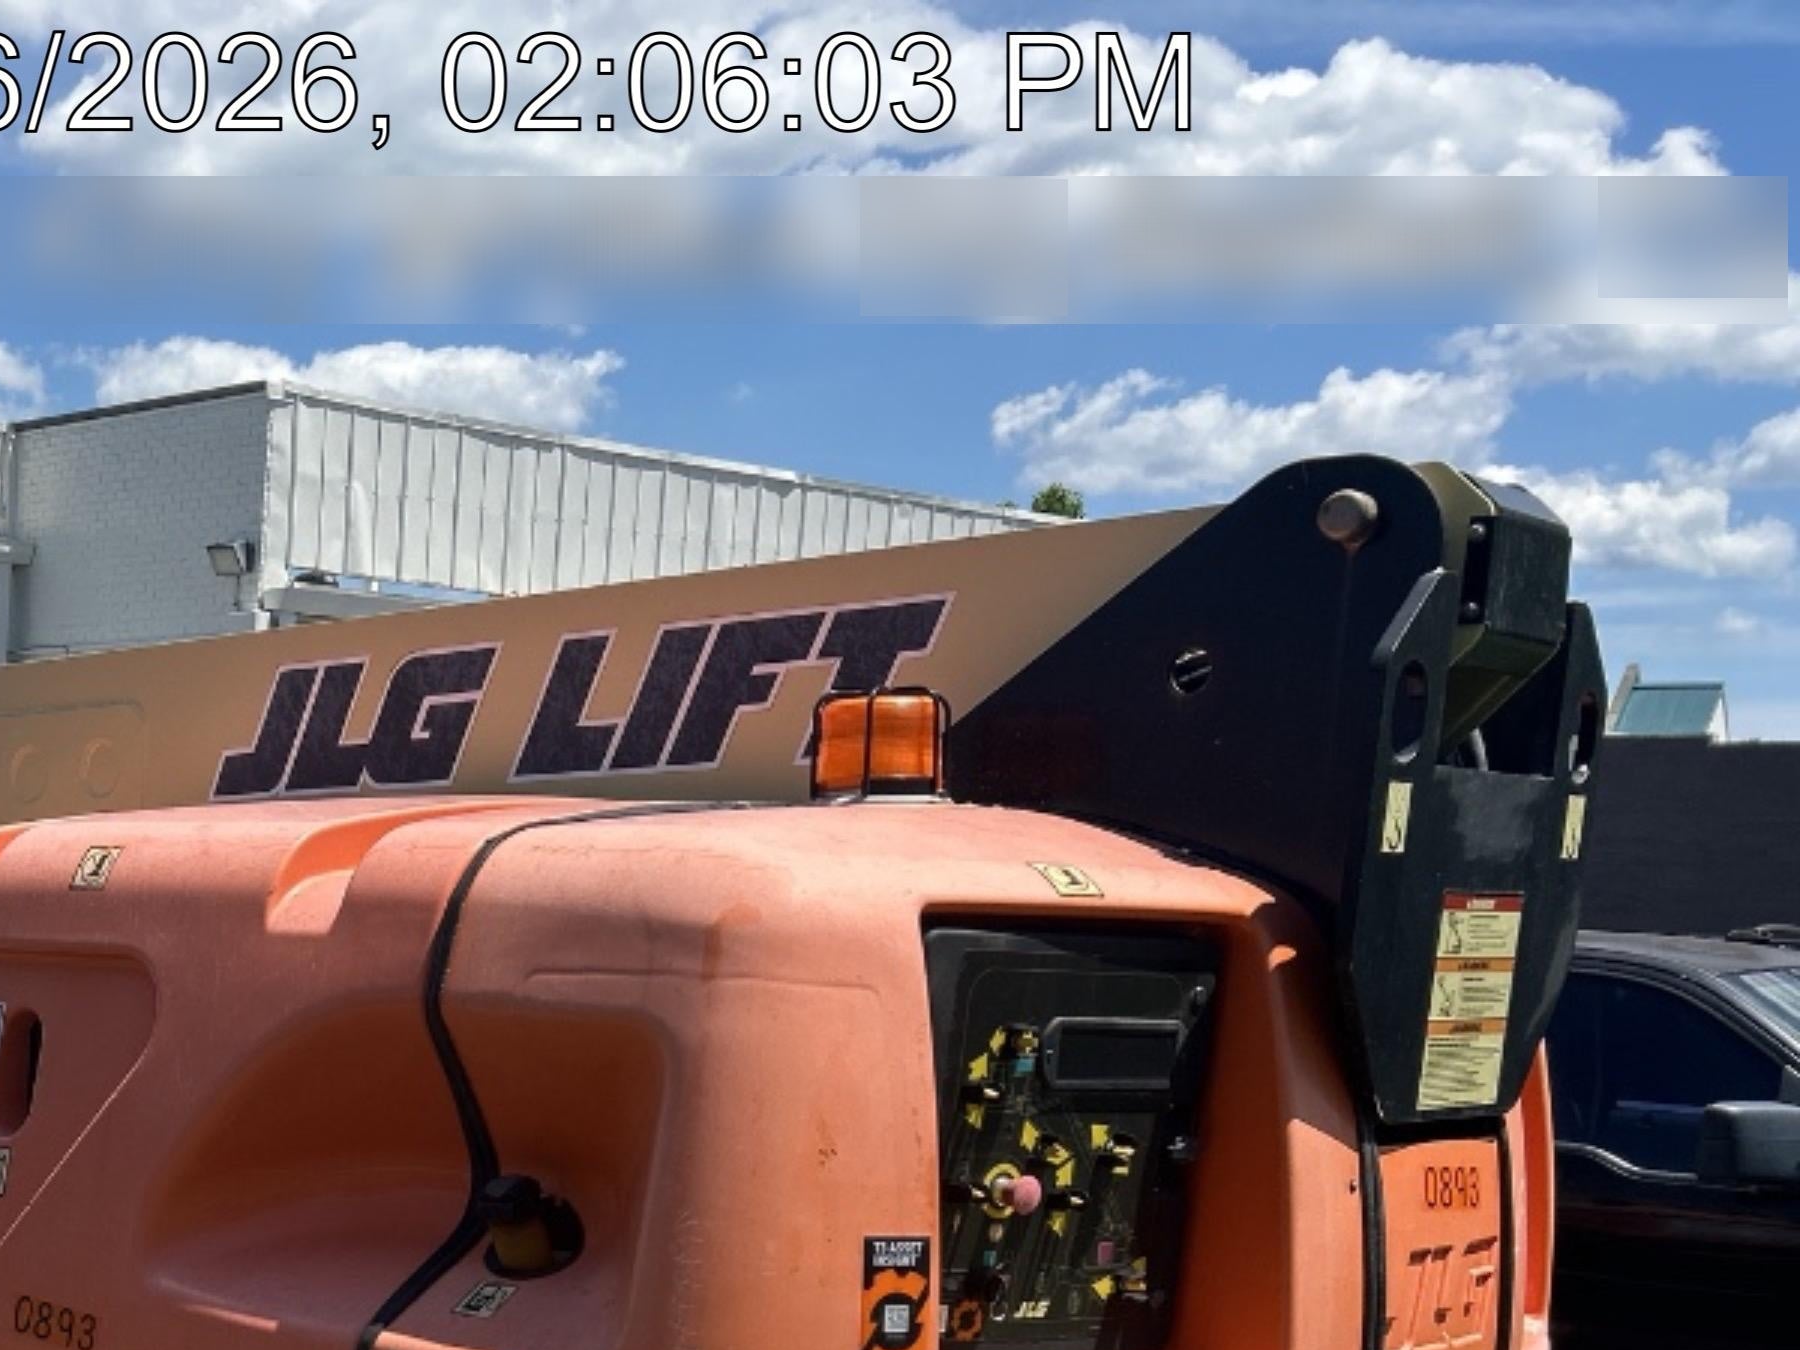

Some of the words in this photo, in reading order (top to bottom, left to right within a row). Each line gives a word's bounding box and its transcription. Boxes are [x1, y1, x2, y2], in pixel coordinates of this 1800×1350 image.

[211, 642, 503, 800] JLG
[508, 590, 957, 782] LIFT
[1423, 1165, 1481, 1209] 0893
